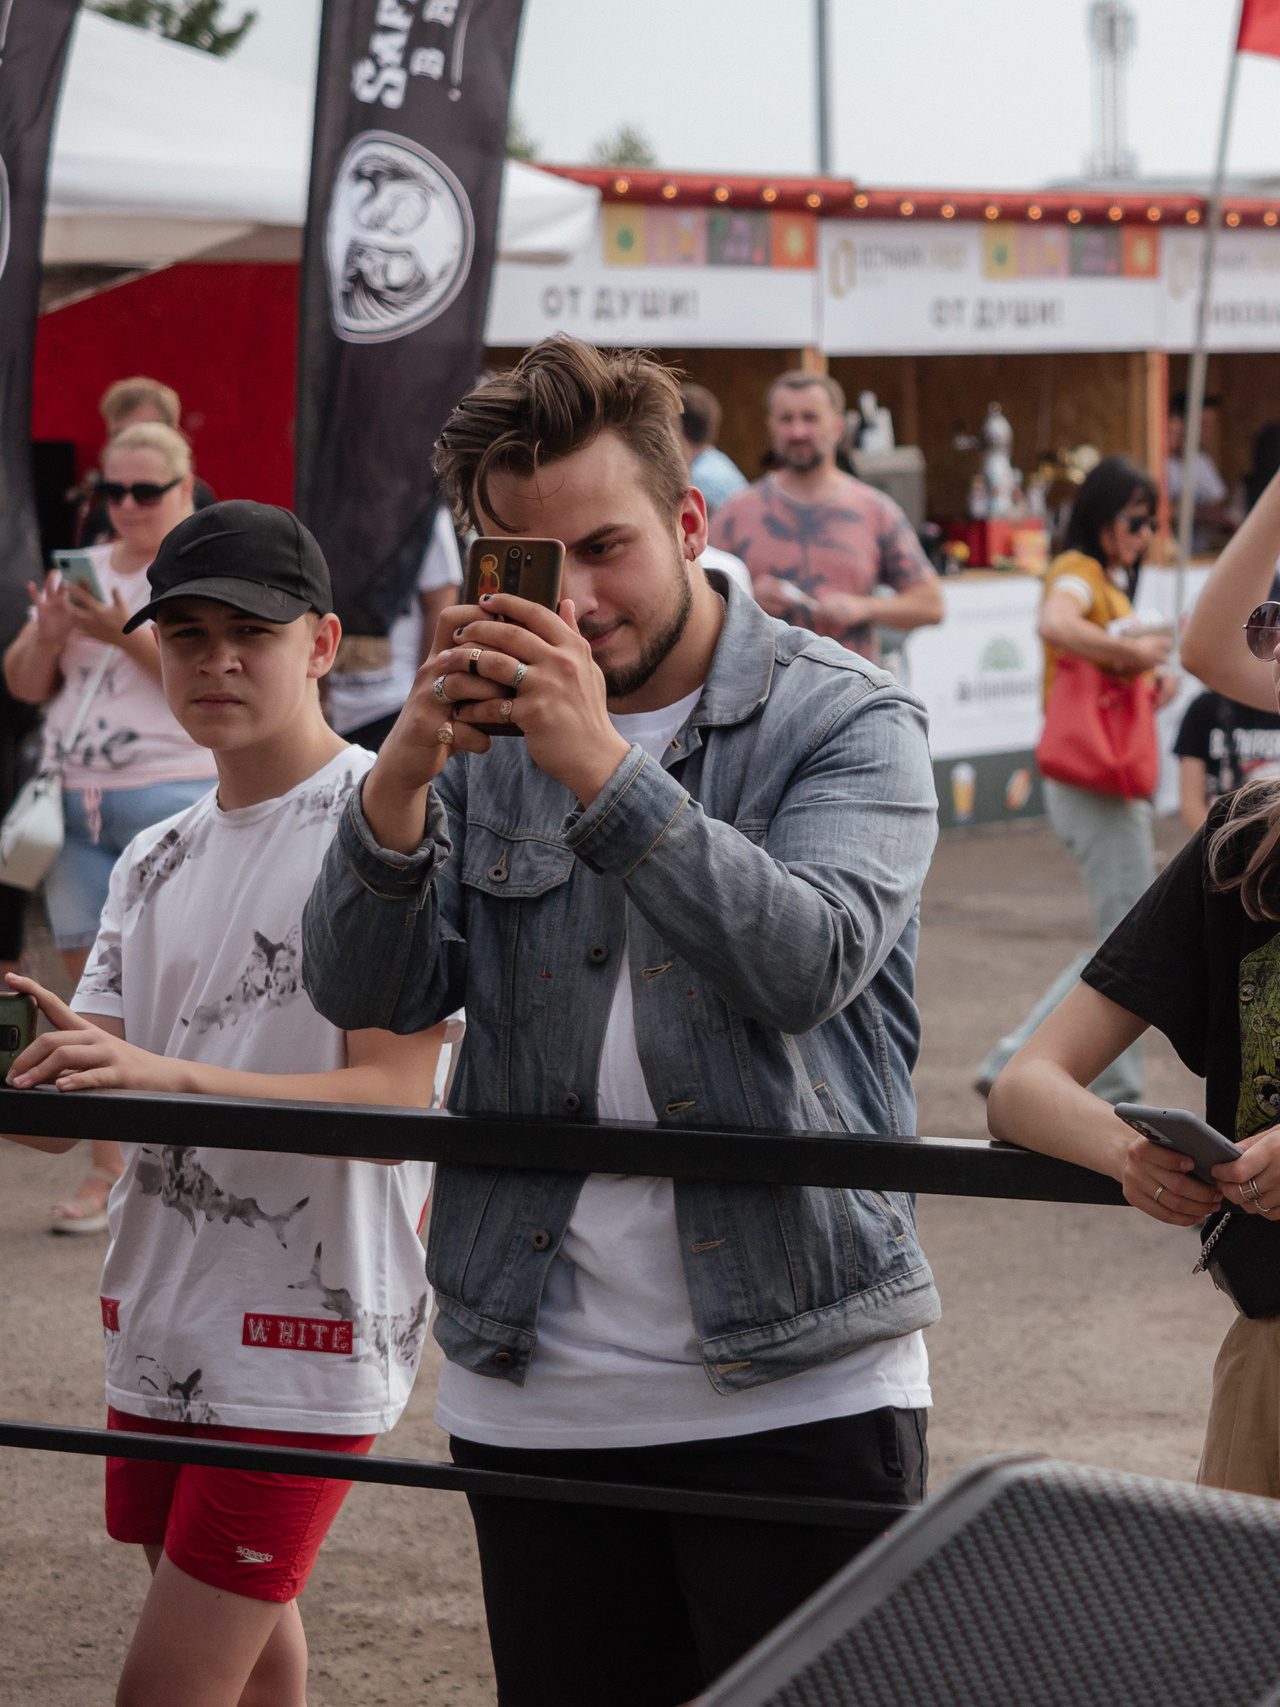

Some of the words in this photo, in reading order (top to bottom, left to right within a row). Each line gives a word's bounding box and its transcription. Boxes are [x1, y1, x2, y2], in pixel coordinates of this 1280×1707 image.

[542, 284, 582, 319] ОТ
[594, 285, 699, 322] ДУШИ!
[931, 296, 967, 329] ОТ
[974, 297, 1064, 331] ДУШИ!
[248, 1317, 350, 1351] WHITE
[236, 1546, 274, 1562] speedo
